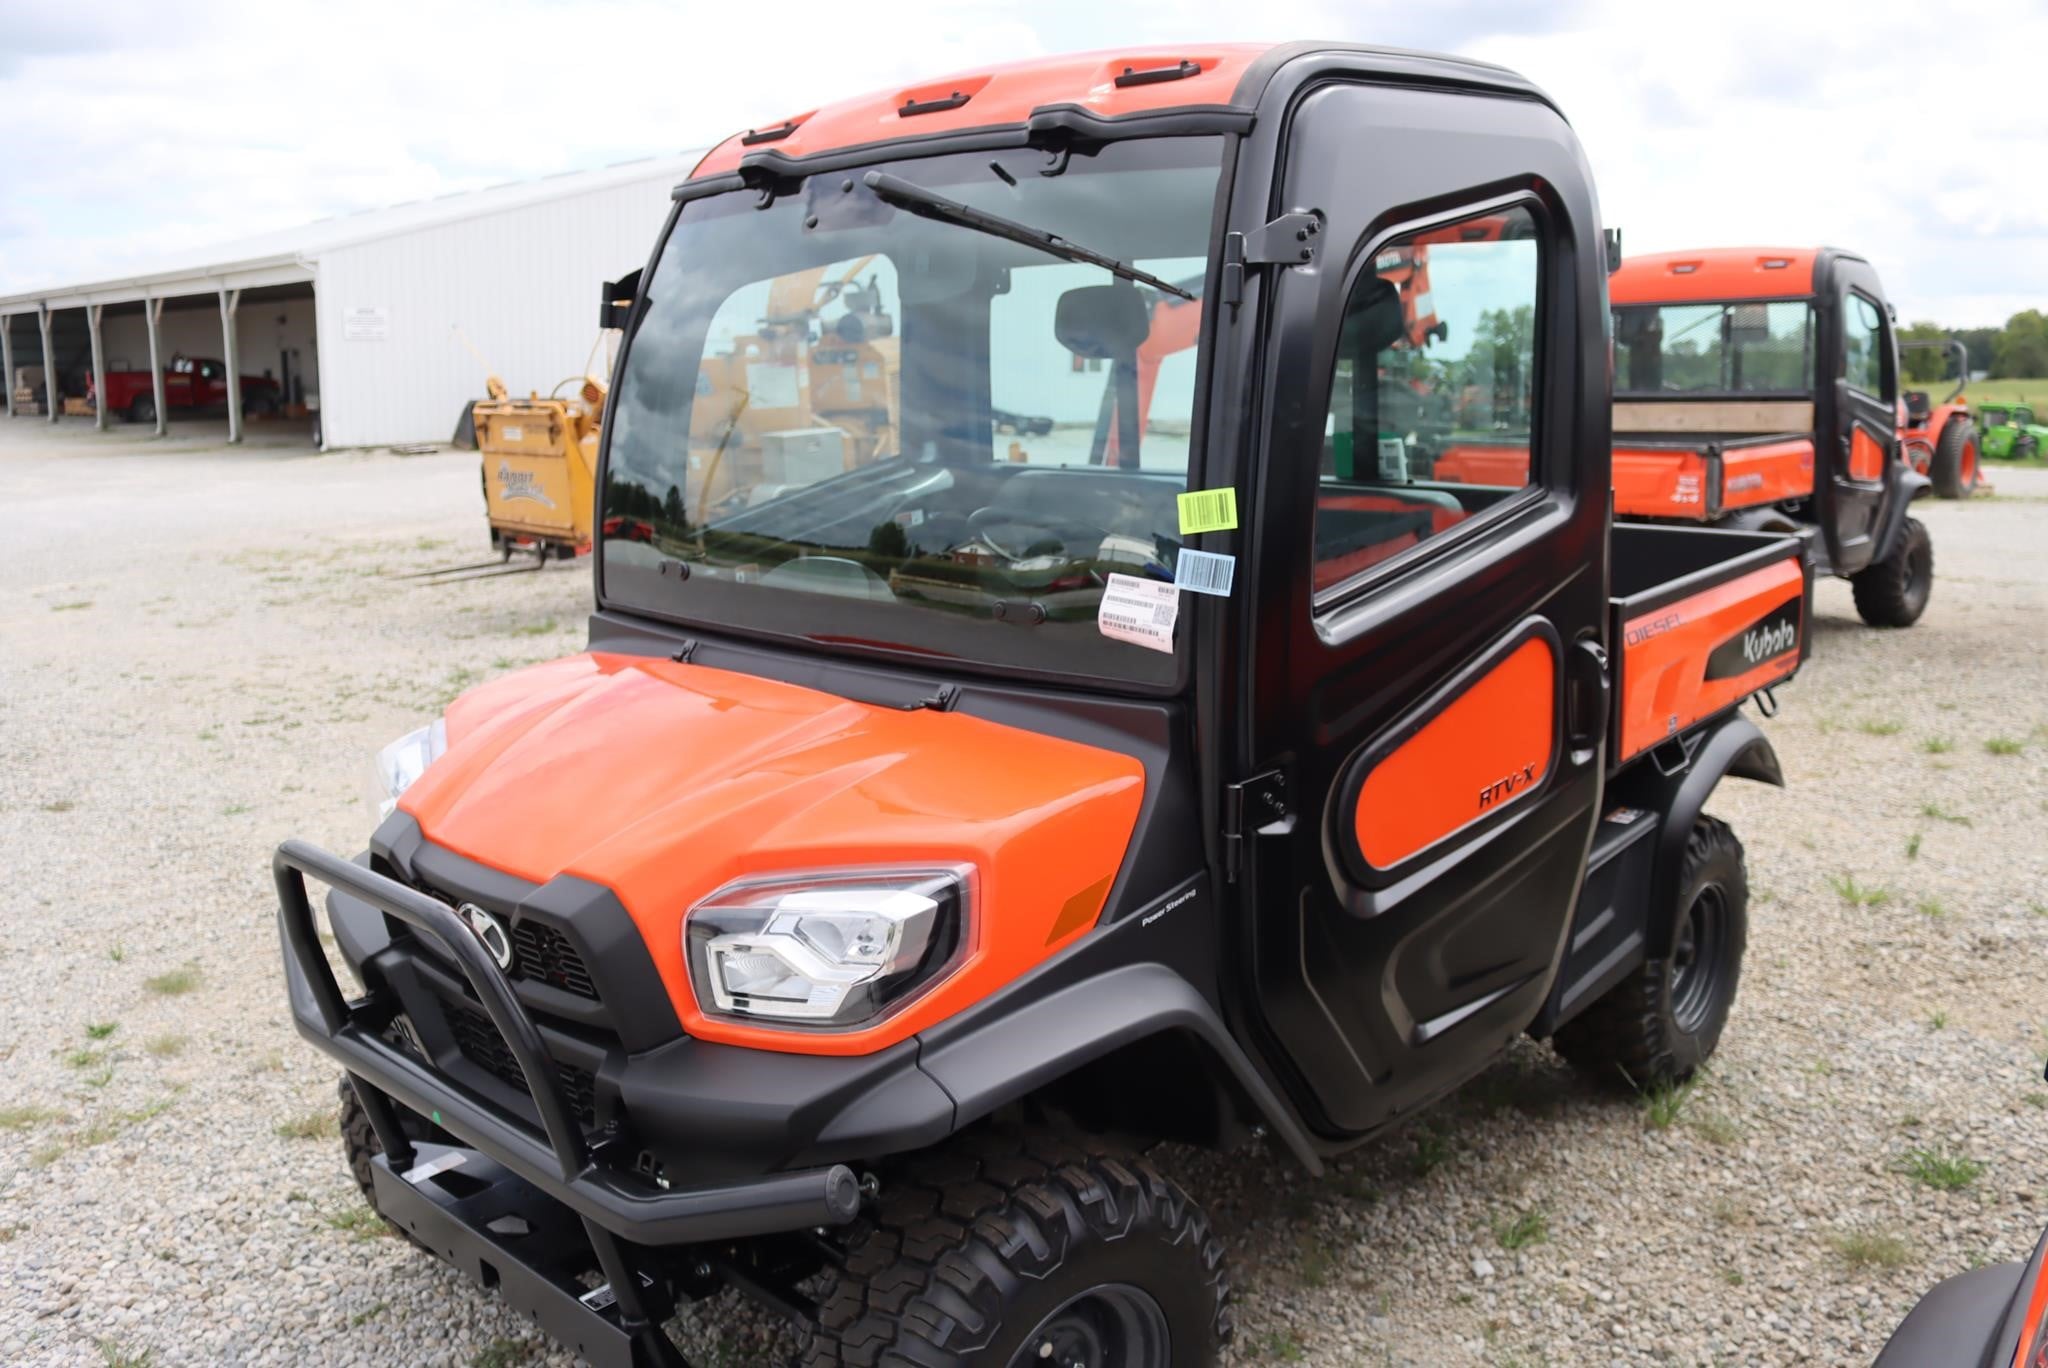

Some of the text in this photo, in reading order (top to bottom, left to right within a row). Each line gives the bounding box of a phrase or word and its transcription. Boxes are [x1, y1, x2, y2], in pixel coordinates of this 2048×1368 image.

[1626, 614, 1685, 646] DIESEL
[1744, 618, 1794, 663] Kubota
[1480, 761, 1535, 808] RTV-X
[1142, 889, 1197, 927] Power Steering
